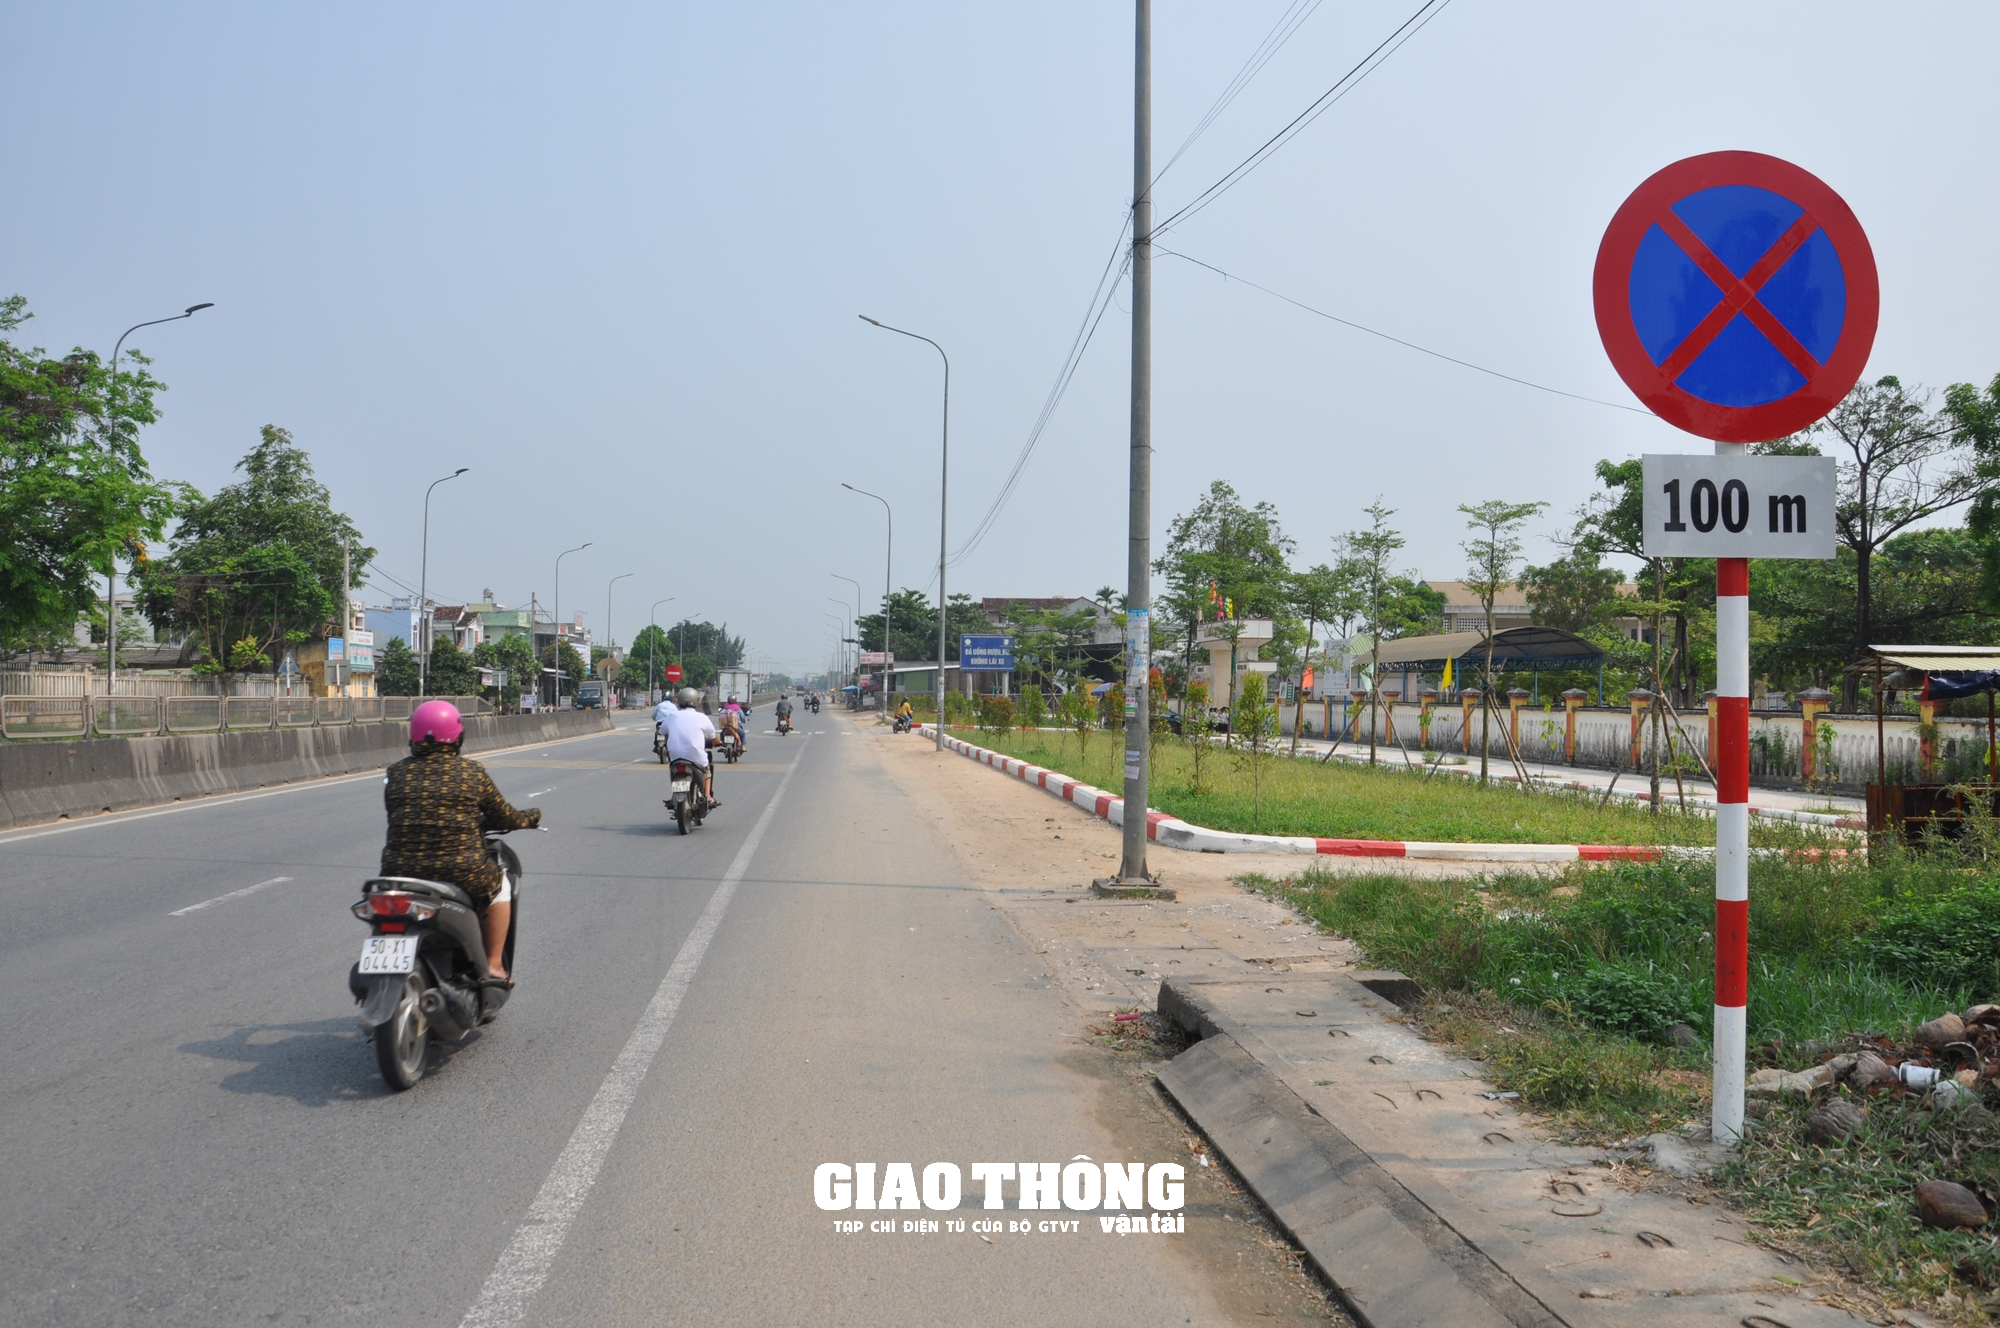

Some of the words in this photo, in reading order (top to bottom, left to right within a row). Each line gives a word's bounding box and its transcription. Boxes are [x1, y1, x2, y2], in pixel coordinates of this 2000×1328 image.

[1663, 478, 1749, 533] 100
[1768, 494, 1807, 533] m
[970, 656, 988, 664] KHÔNG
[989, 656, 997, 664] LÁI
